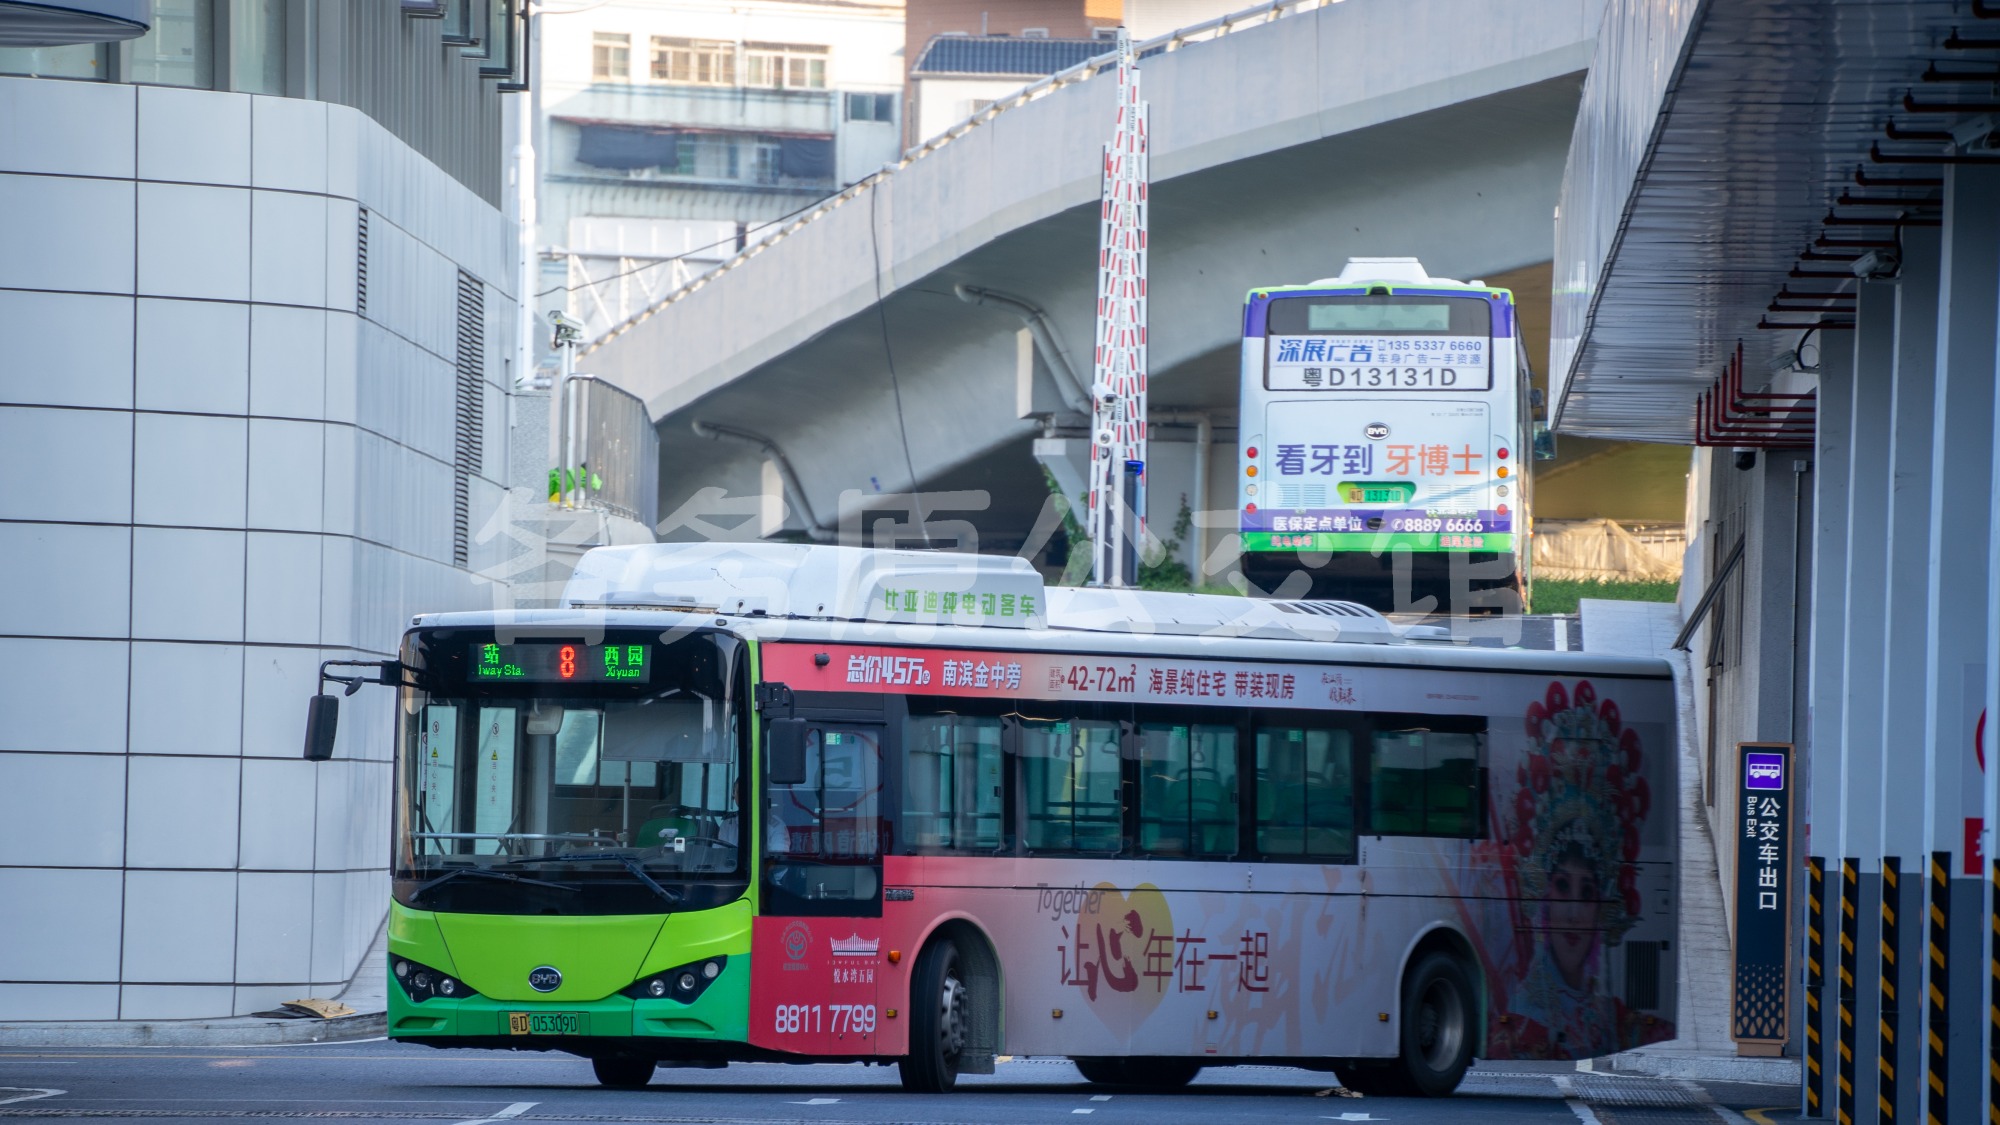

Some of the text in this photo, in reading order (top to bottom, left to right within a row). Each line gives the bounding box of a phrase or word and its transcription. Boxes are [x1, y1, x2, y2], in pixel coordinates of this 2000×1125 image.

[1277, 339, 1373, 362] 深展广告
[1388, 340, 1482, 351] 135 5337 6660
[1377, 353, 1481, 365] 车身广告一手资源
[1302, 368, 1457, 387] 粤D13131D
[1276, 443, 1483, 476] 看牙到 牙博士
[1273, 516, 1363, 531] 医保定点单位
[1404, 519, 1483, 532] 8889 6666
[885, 588, 1035, 617] 比亚迪纯电动客车
[560, 646, 575, 678] 8
[604, 645, 643, 666] 西园
[606, 666, 640, 679] Xiyuan
[942, 659, 1022, 690] 南滨金中旁
[1149, 668, 1227, 697] 海景纯住宅
[1235, 671, 1296, 700] 带装现房
[1746, 796, 1757, 838] Bus Exit
[1758, 797, 1781, 910] 公交车出口
[1036, 881, 1105, 921] Together
[531, 973, 558, 985] BYD
[775, 1004, 876, 1033] 8811 7799
